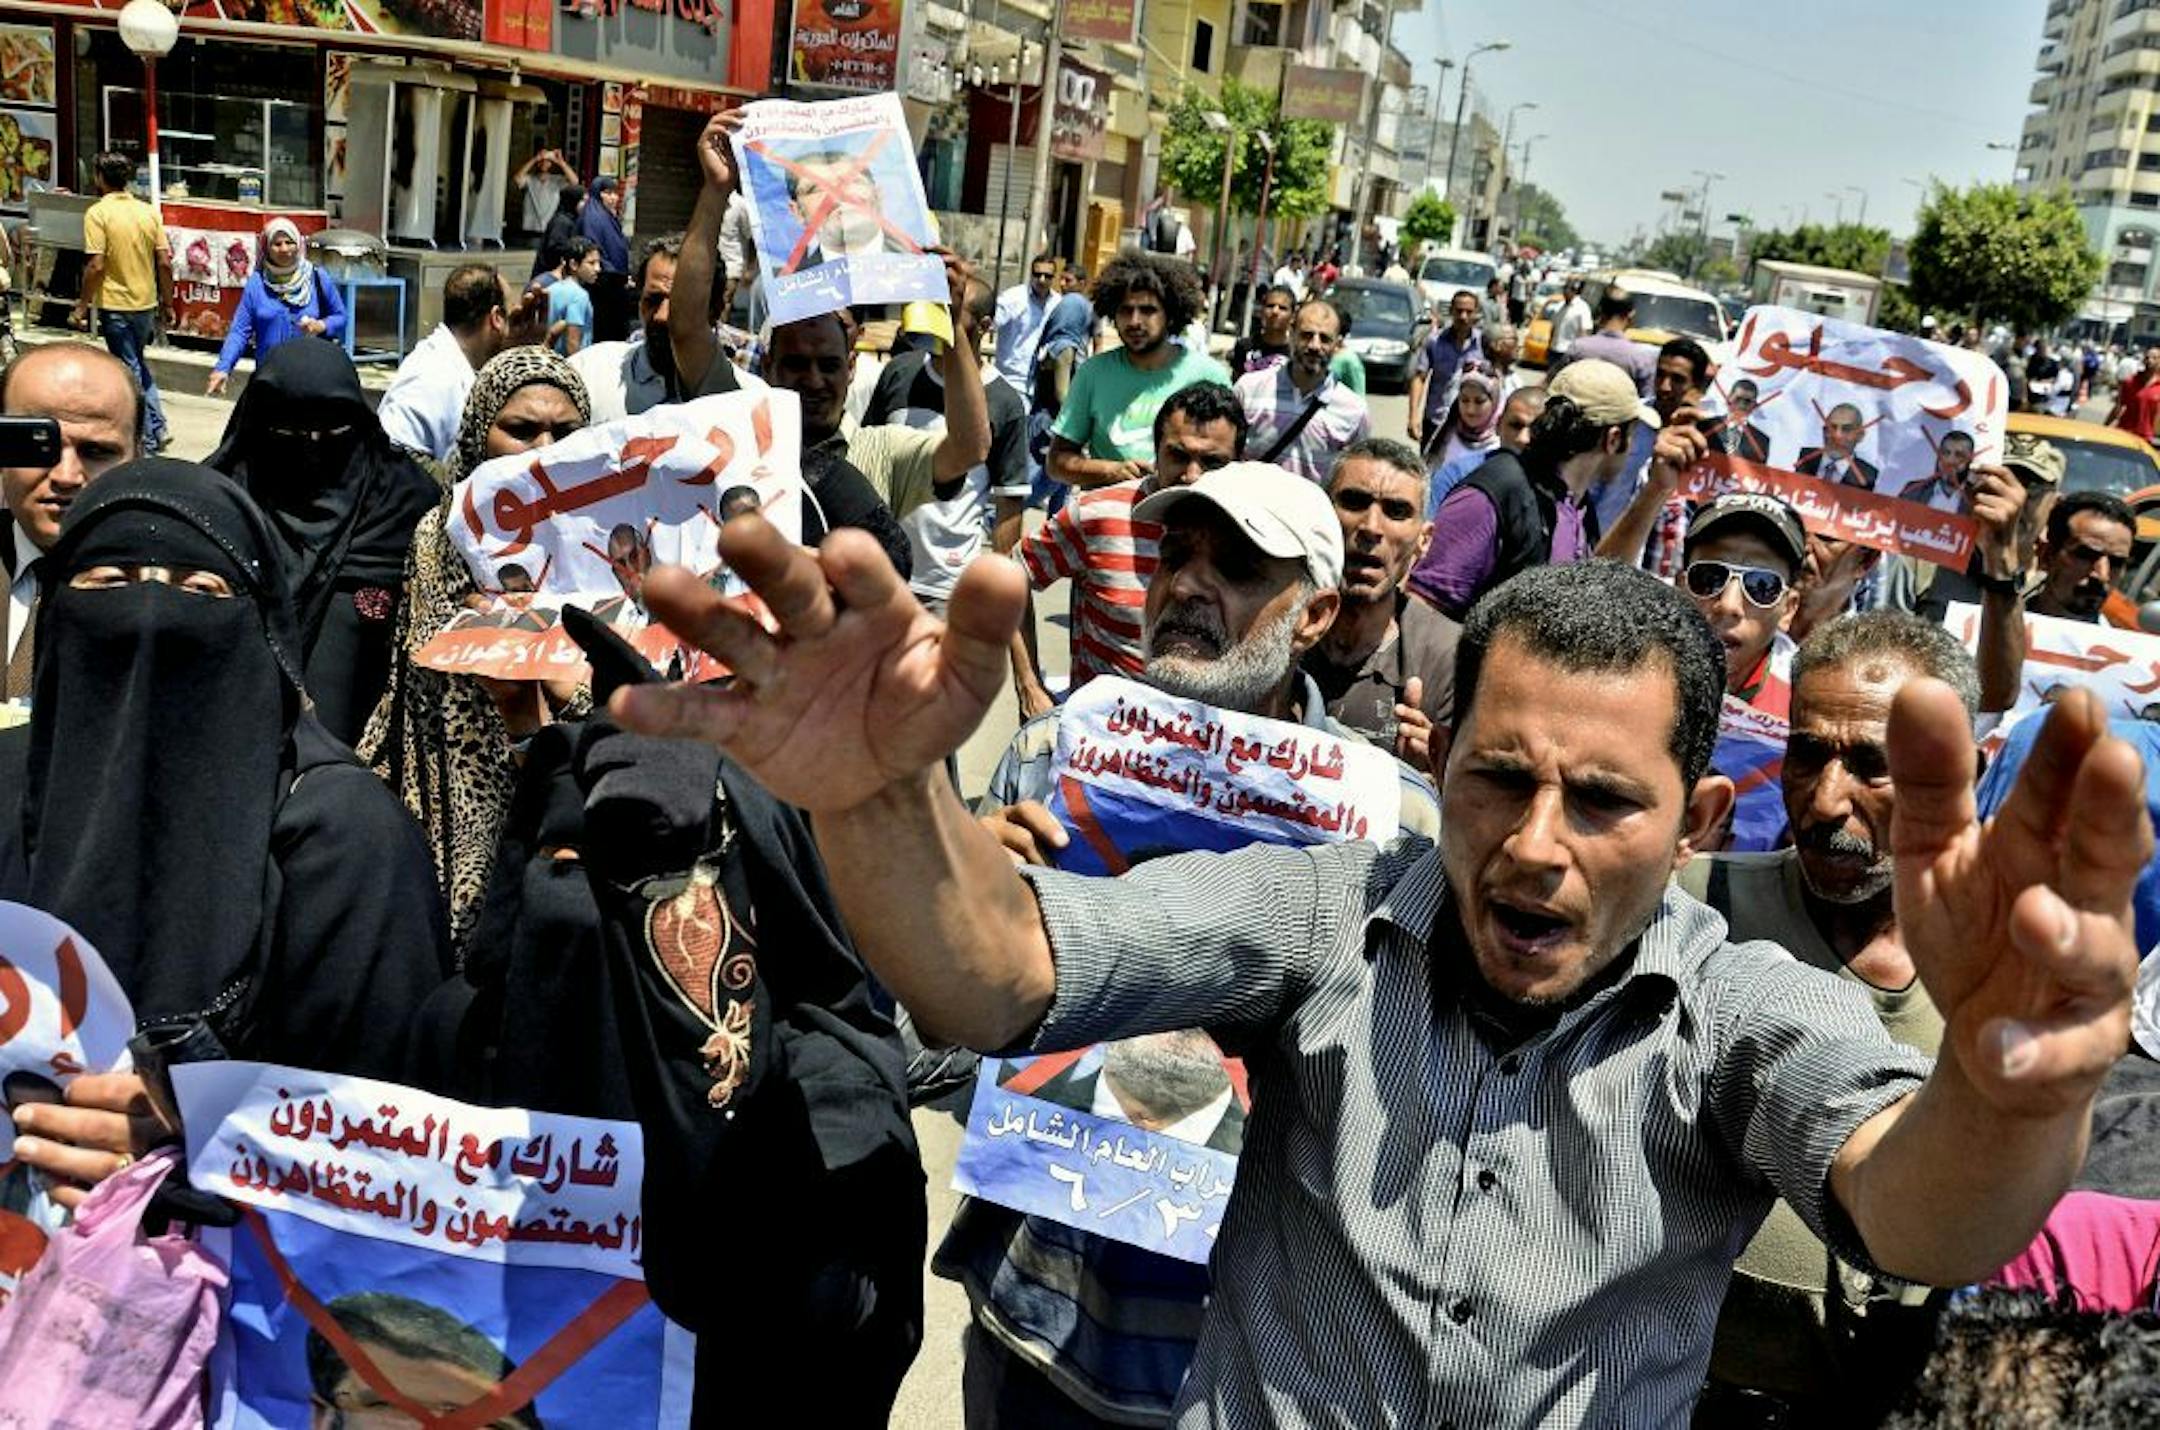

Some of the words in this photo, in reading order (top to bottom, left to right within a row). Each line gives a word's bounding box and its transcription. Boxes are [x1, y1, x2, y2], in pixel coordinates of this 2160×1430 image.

[1841, 506, 1898, 545] يريد
[1900, 519, 1970, 555] الشعب
[1107, 696, 1224, 756] المتمردون
[1069, 737, 1212, 808] والمتظاهرون
[1226, 736, 1262, 775] مع
[1267, 740, 1345, 781] شارك
[270, 1088, 450, 1163] المتمردون
[986, 1103, 1091, 1157] الشامل
[453, 1132, 502, 1185] مع
[510, 1132, 620, 1195] شارك
[1090, 1136, 1168, 1176] العام
[229, 1142, 439, 1236] والمتظاهرون
[443, 1198, 643, 1266] المعتصمون
